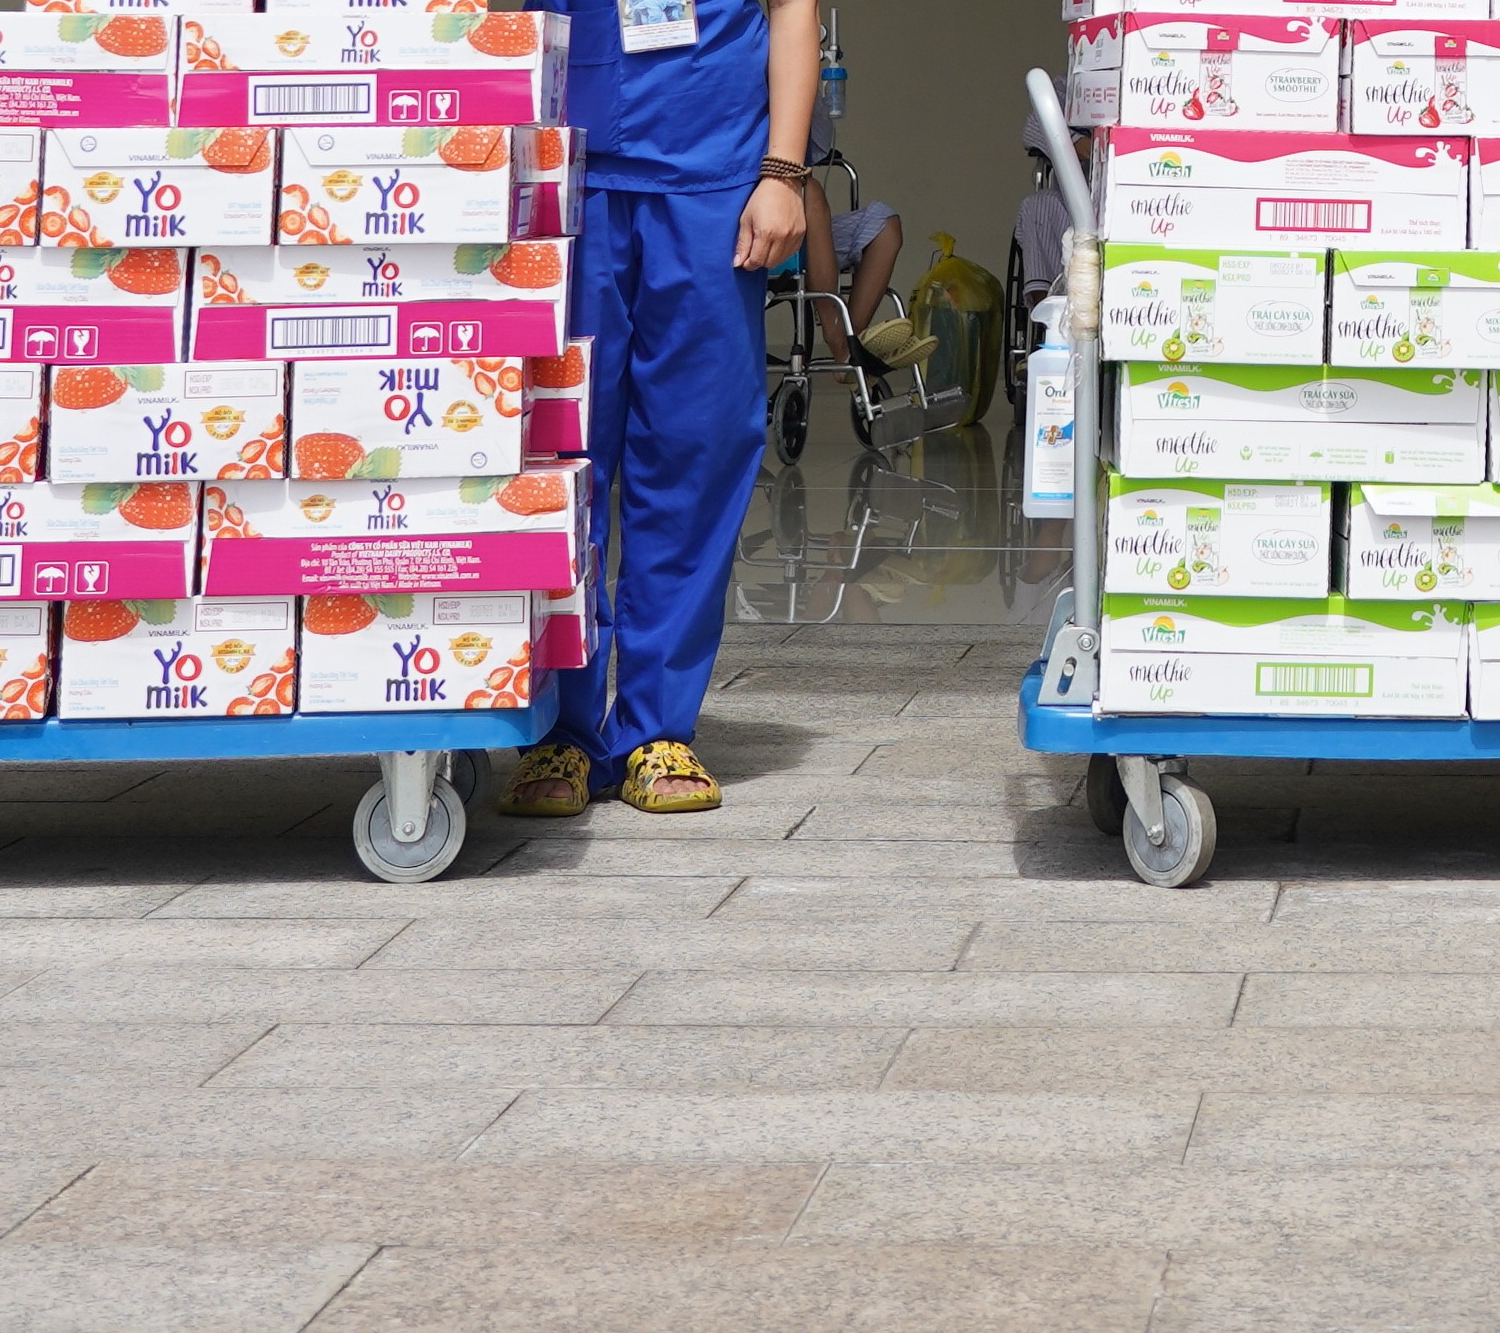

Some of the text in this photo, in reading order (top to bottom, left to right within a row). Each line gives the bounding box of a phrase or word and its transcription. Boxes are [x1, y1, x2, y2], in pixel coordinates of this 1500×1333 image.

[1130, 71, 1196, 98] smoothie
[1269, 75, 1322, 85] STRAWBERRY
[1273, 84, 1318, 93] SMOOTHIE
